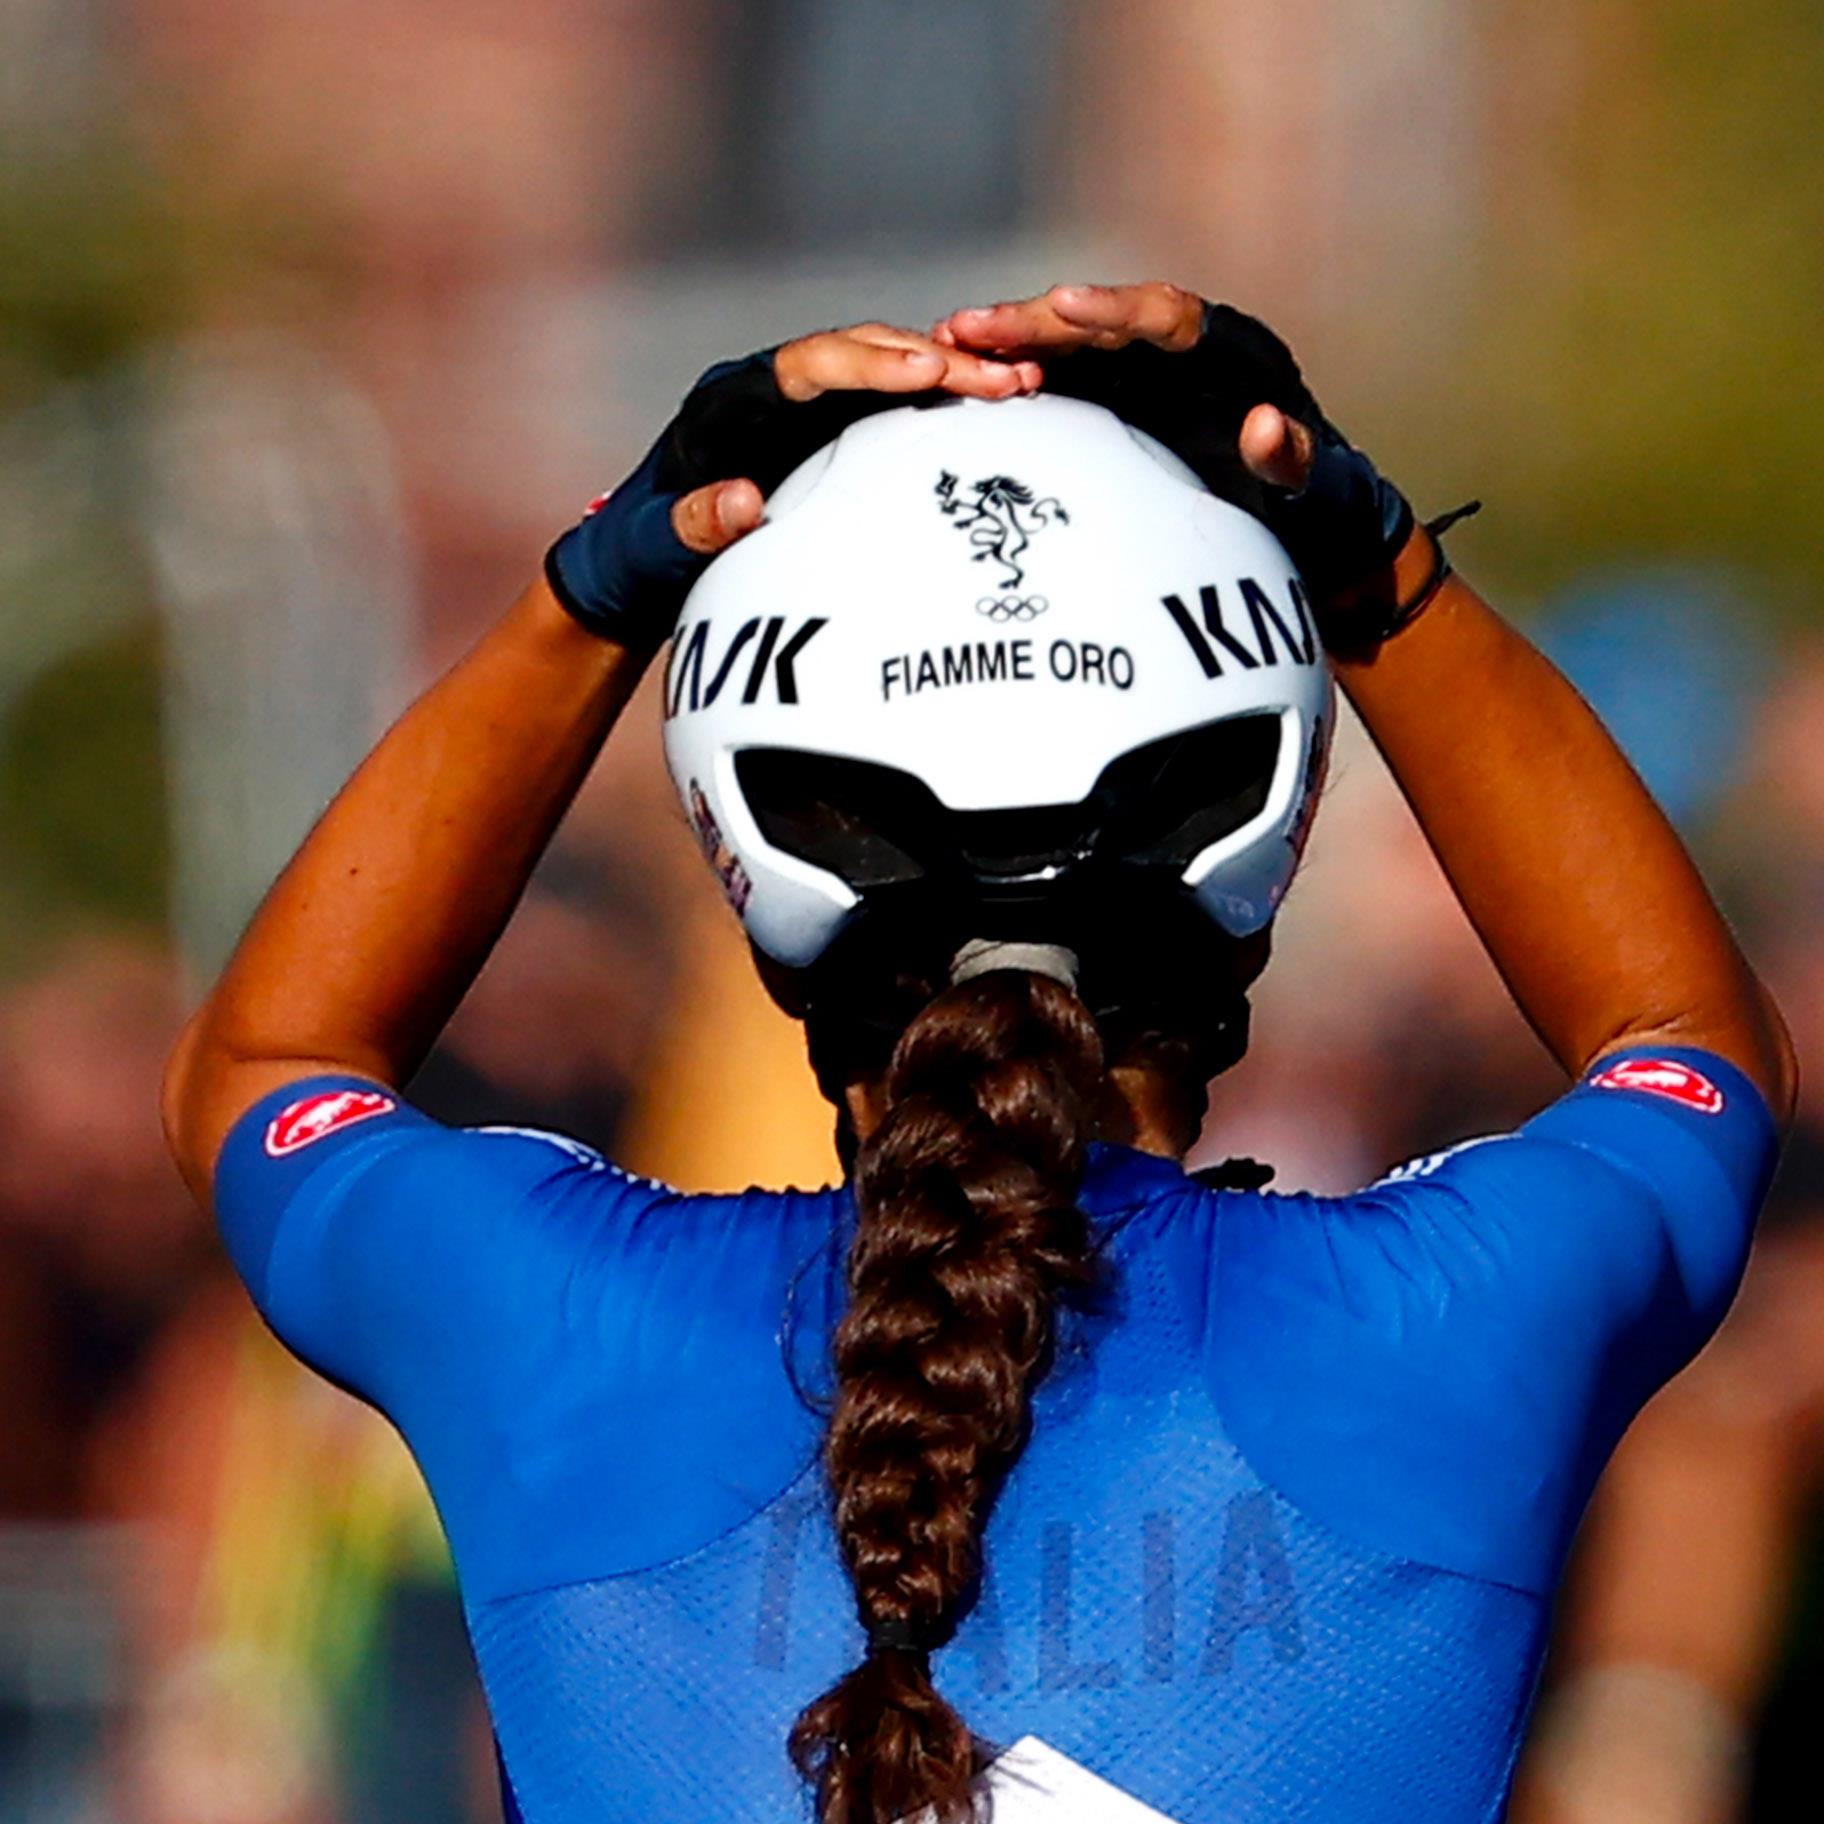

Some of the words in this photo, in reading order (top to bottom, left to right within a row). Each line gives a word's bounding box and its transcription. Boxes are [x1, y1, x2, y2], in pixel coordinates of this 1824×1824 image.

[663, 616, 830, 721] ASK
[880, 639, 1035, 703] FIAMME
[1048, 638, 1135, 691] ORO
